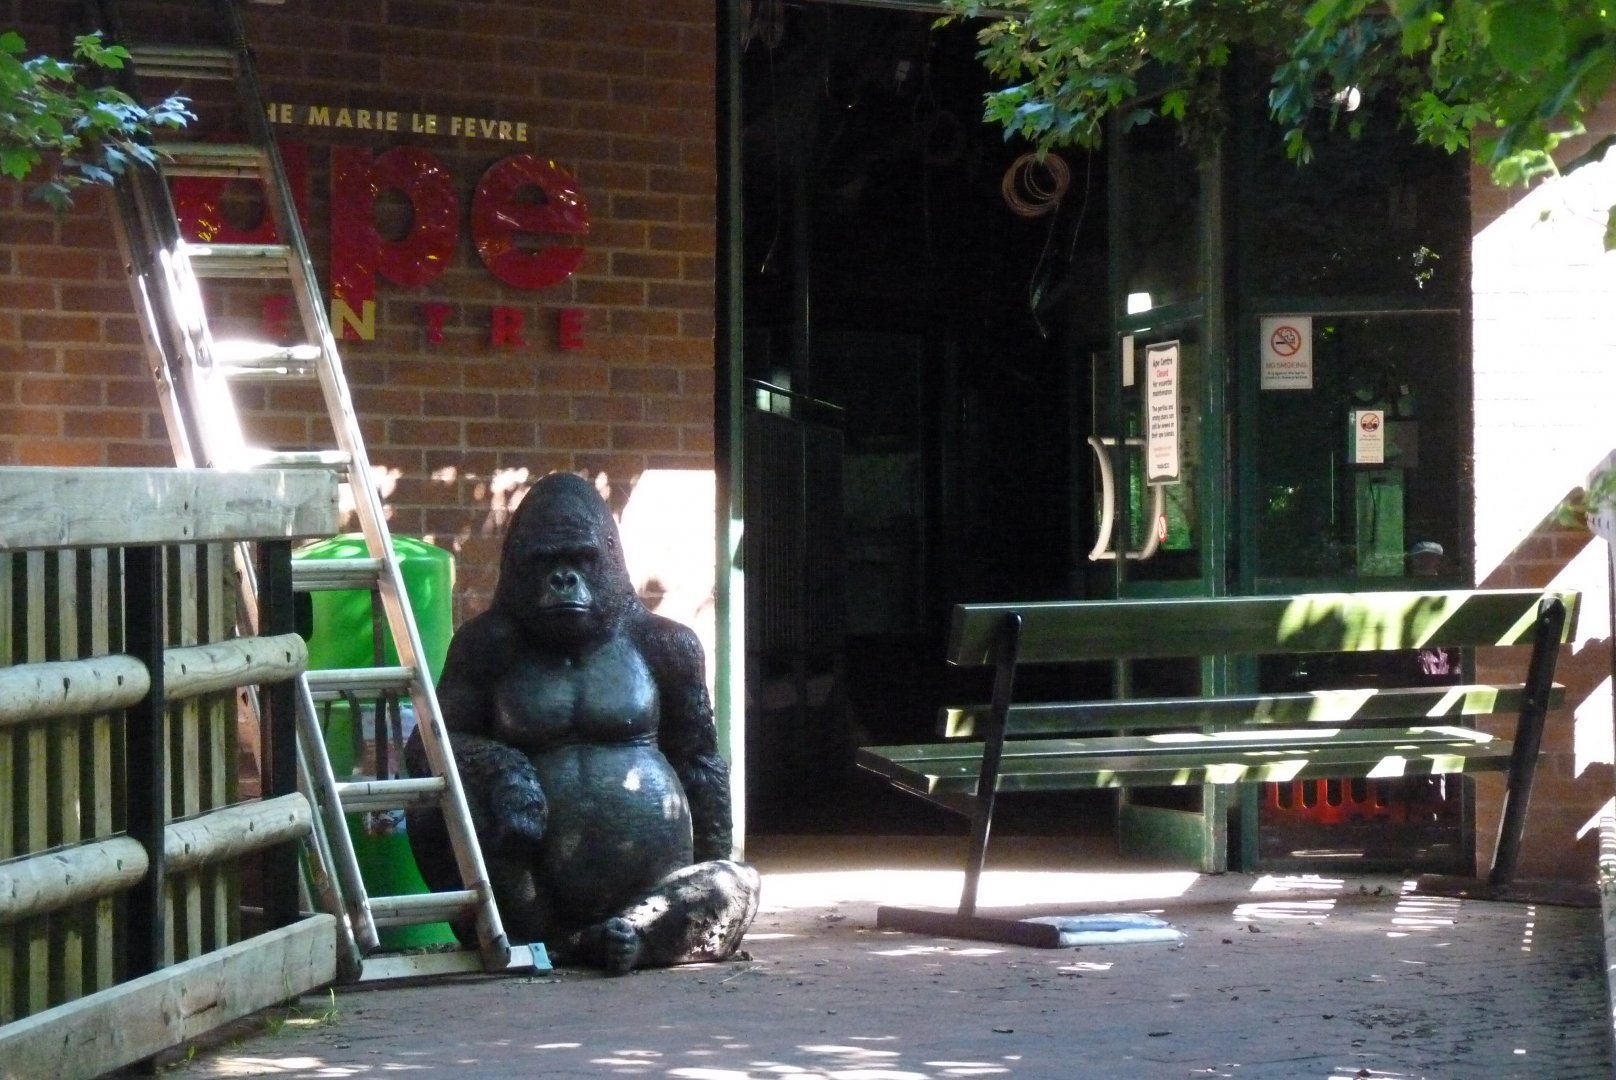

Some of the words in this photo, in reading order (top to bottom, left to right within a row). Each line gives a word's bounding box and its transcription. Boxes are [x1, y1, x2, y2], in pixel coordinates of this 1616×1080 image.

[266, 102, 293, 125] HE
[308, 105, 398, 131] MARIE
[411, 113, 437, 134] LE
[451, 116, 528, 141] FEVRE
[261, 295, 589, 351] ENTRE
